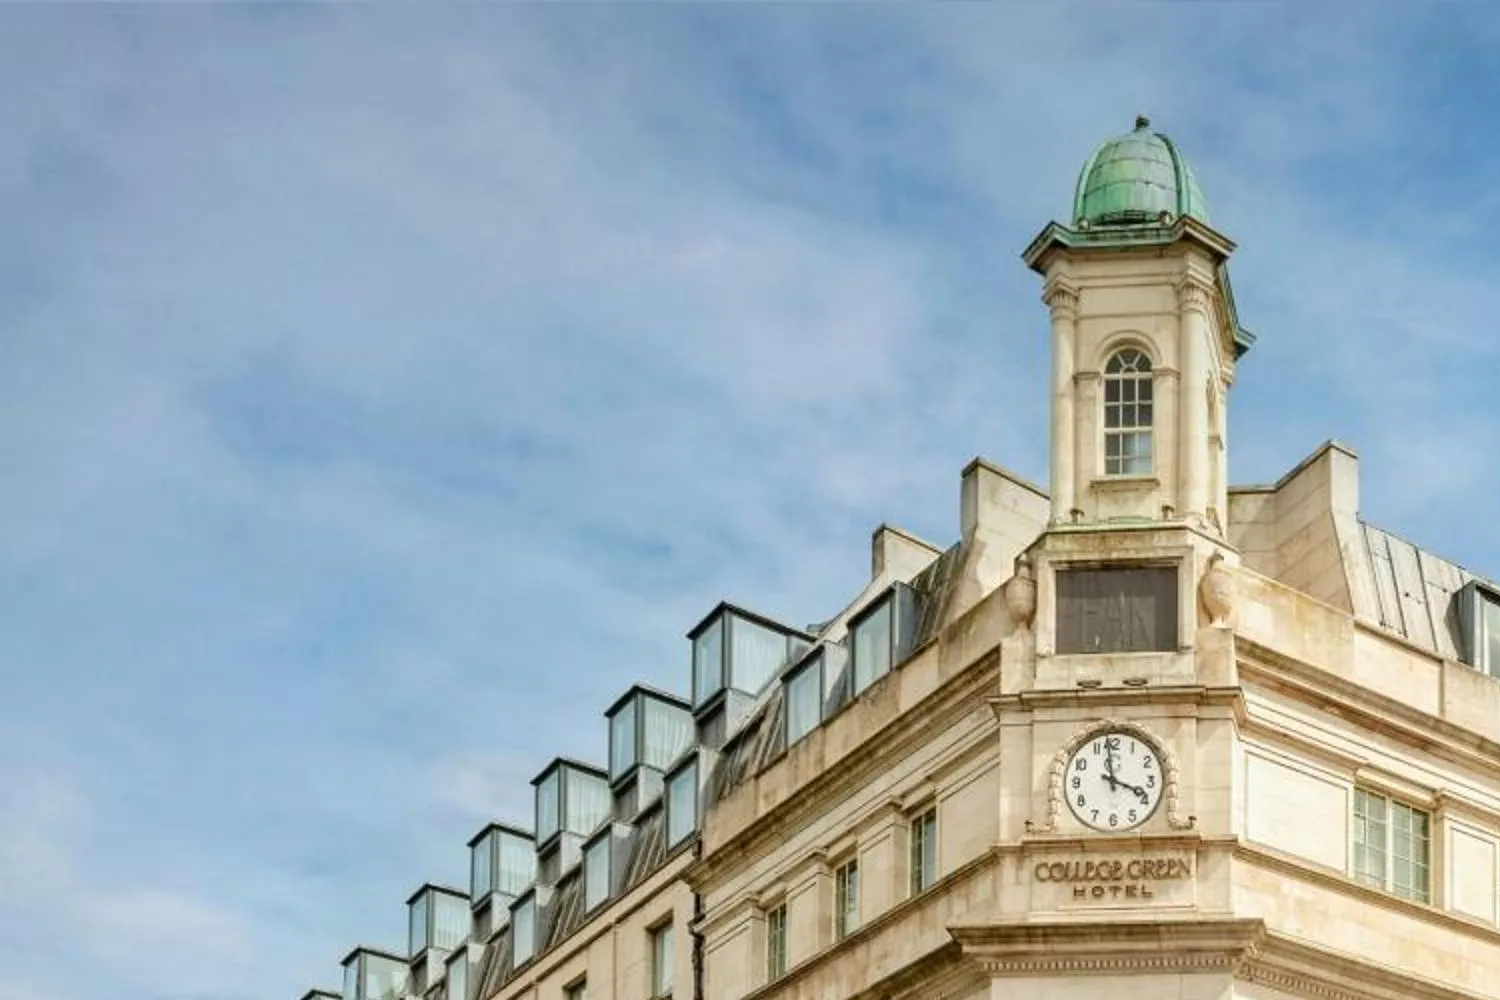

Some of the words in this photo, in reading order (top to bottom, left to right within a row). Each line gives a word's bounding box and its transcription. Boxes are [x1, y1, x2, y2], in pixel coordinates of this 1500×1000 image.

[1093, 742, 1101, 755] 11
[1075, 758, 1087, 771] 10
[1143, 755, 1152, 769] 2
[1071, 776, 1080, 789] 9
[1146, 775, 1155, 789] 3
[1077, 794, 1086, 807] 8
[1139, 792, 1149, 806] 4
[1091, 809, 1099, 821] 7
[1109, 813, 1118, 827] 6
[1128, 809, 1137, 822] 5
[1035, 861, 1123, 883] COLLEGE
[1127, 859, 1190, 880] GREEN
[1073, 884, 1153, 899] HOTEL
